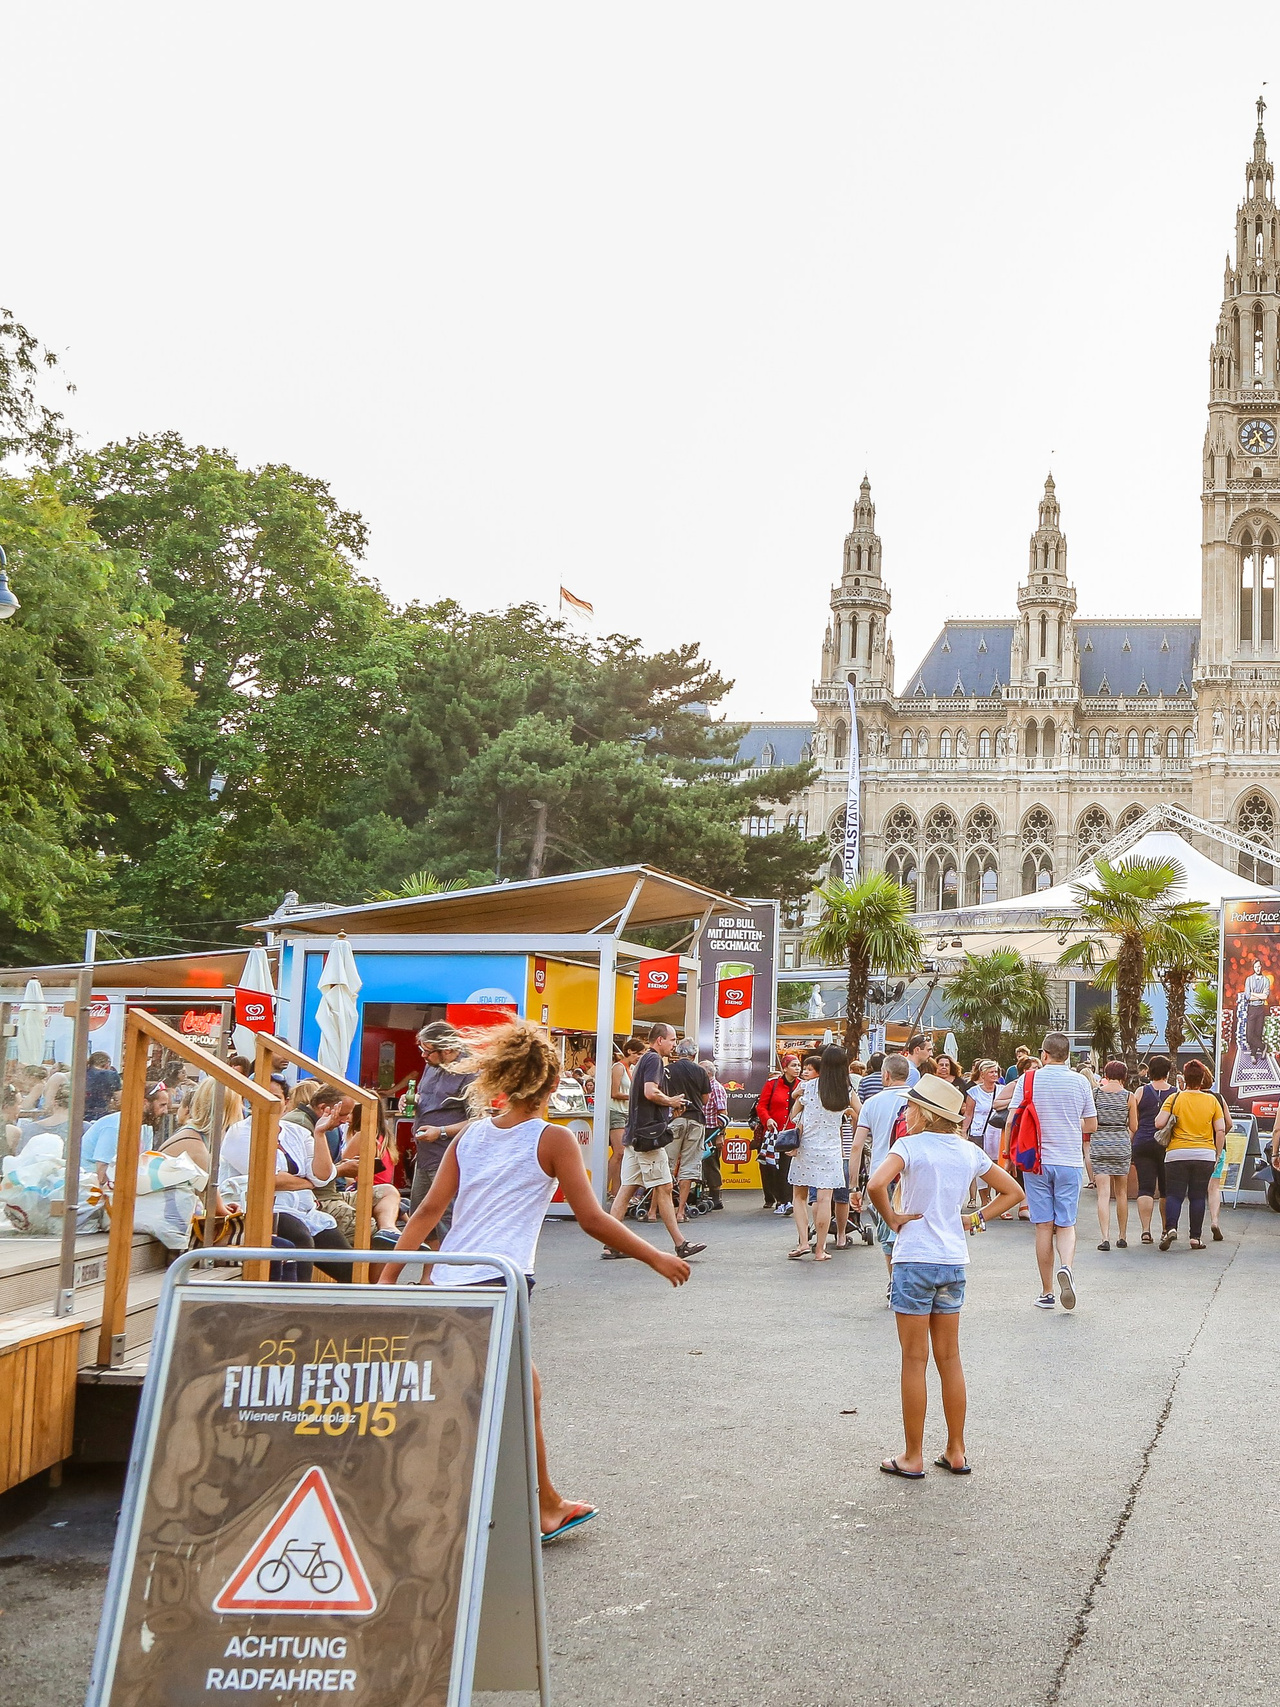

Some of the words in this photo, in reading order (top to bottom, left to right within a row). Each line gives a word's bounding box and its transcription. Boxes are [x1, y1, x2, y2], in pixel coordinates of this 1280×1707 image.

[719, 917, 735, 928] RED
[736, 918, 756, 929] BULL
[1231, 911, 1279, 924] Pokerface
[707, 929, 723, 939] MIT
[724, 930, 766, 941] LIMETTEN-
[710, 940, 763, 952] GESCHMACK.
[727, 1142, 748, 1153] Ciao
[726, 1153, 748, 1162] ALLTAG!
[257, 1339, 296, 1369] 25
[308, 1335, 410, 1367] JAHRE
[222, 1364, 294, 1409] FILM
[300, 1360, 436, 1406] FESTIVAL
[238, 1409, 279, 1423] Wiener
[281, 1410, 357, 1425] Rathausplatz
[294, 1401, 398, 1436] 2015
[223, 1635, 348, 1660] ACHTUNG
[204, 1668, 357, 1692] RADFAHRER
